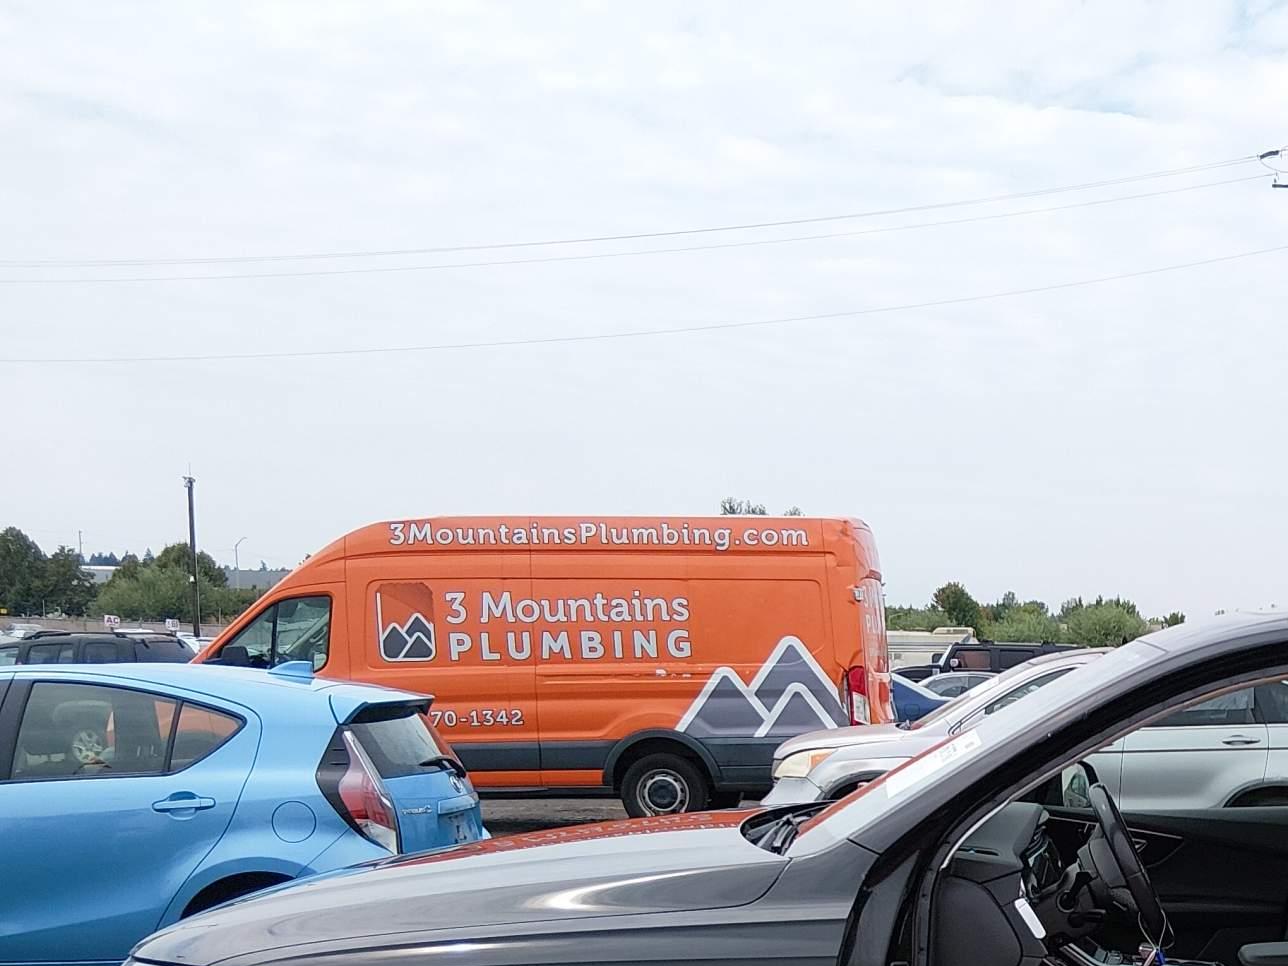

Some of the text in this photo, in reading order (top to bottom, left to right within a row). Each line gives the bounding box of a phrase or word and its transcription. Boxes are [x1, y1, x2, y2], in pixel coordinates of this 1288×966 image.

[388, 521, 810, 551] 3MountainsPlumbing.com
[445, 590, 691, 624] 3 Mountains
[448, 629, 693, 662] PLUMBING
